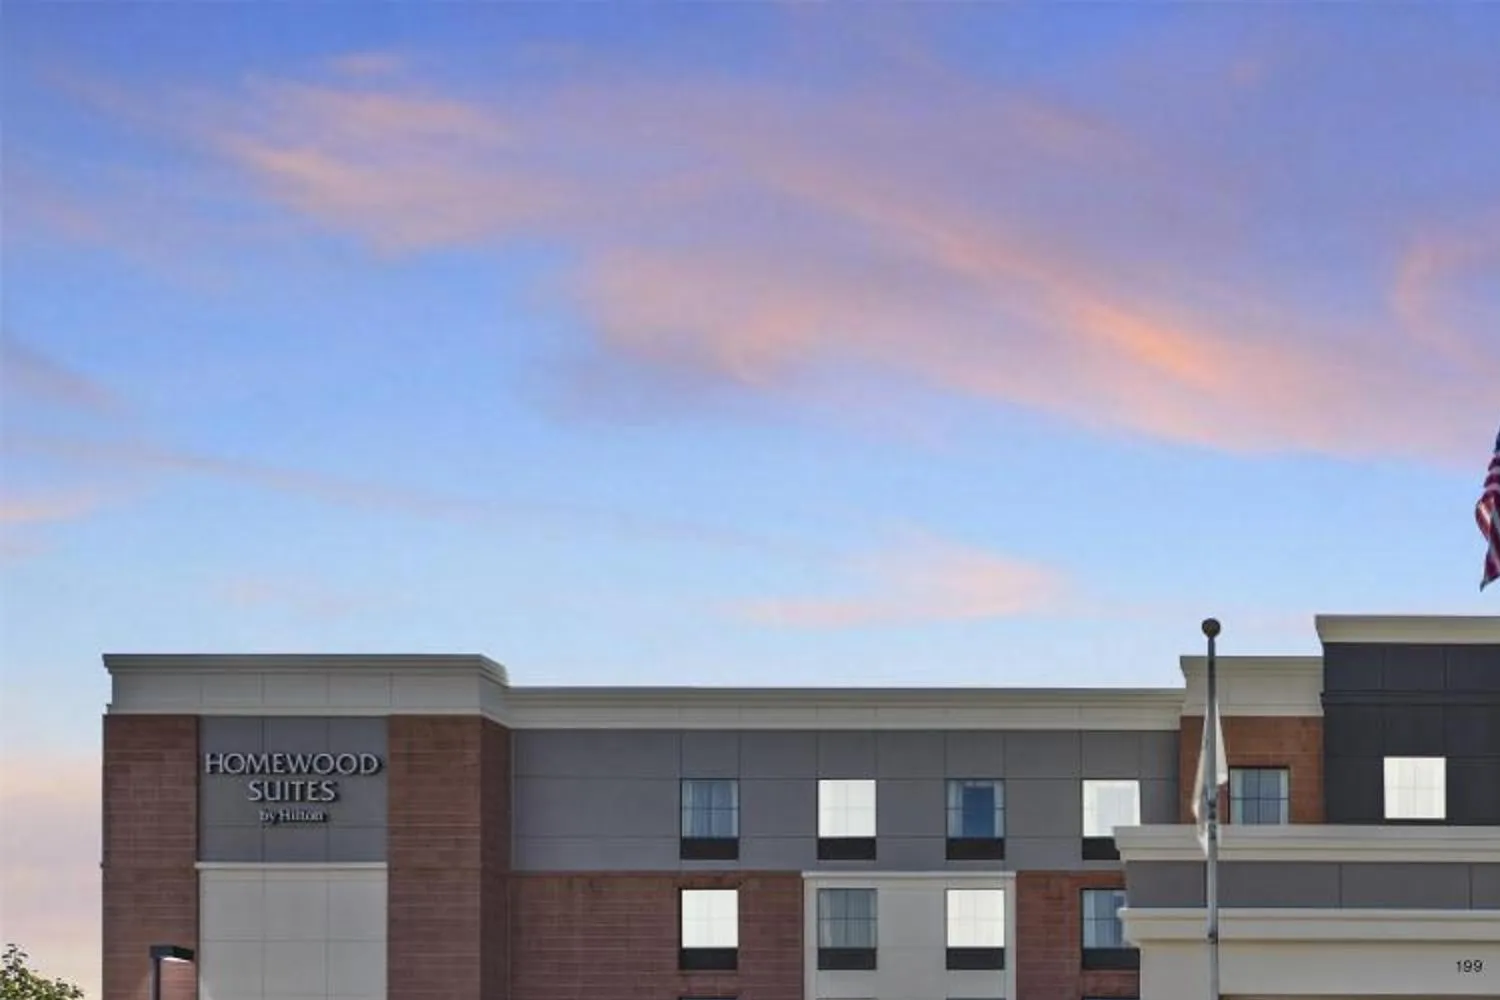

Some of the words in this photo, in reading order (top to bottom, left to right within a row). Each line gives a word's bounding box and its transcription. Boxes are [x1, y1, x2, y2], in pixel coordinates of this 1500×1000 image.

[204, 753, 381, 774] HOMEWOOD
[248, 779, 337, 802] SUITES
[259, 808, 279, 825] by
[279, 808, 325, 821] Hilton
[1456, 959, 1483, 973] 199
